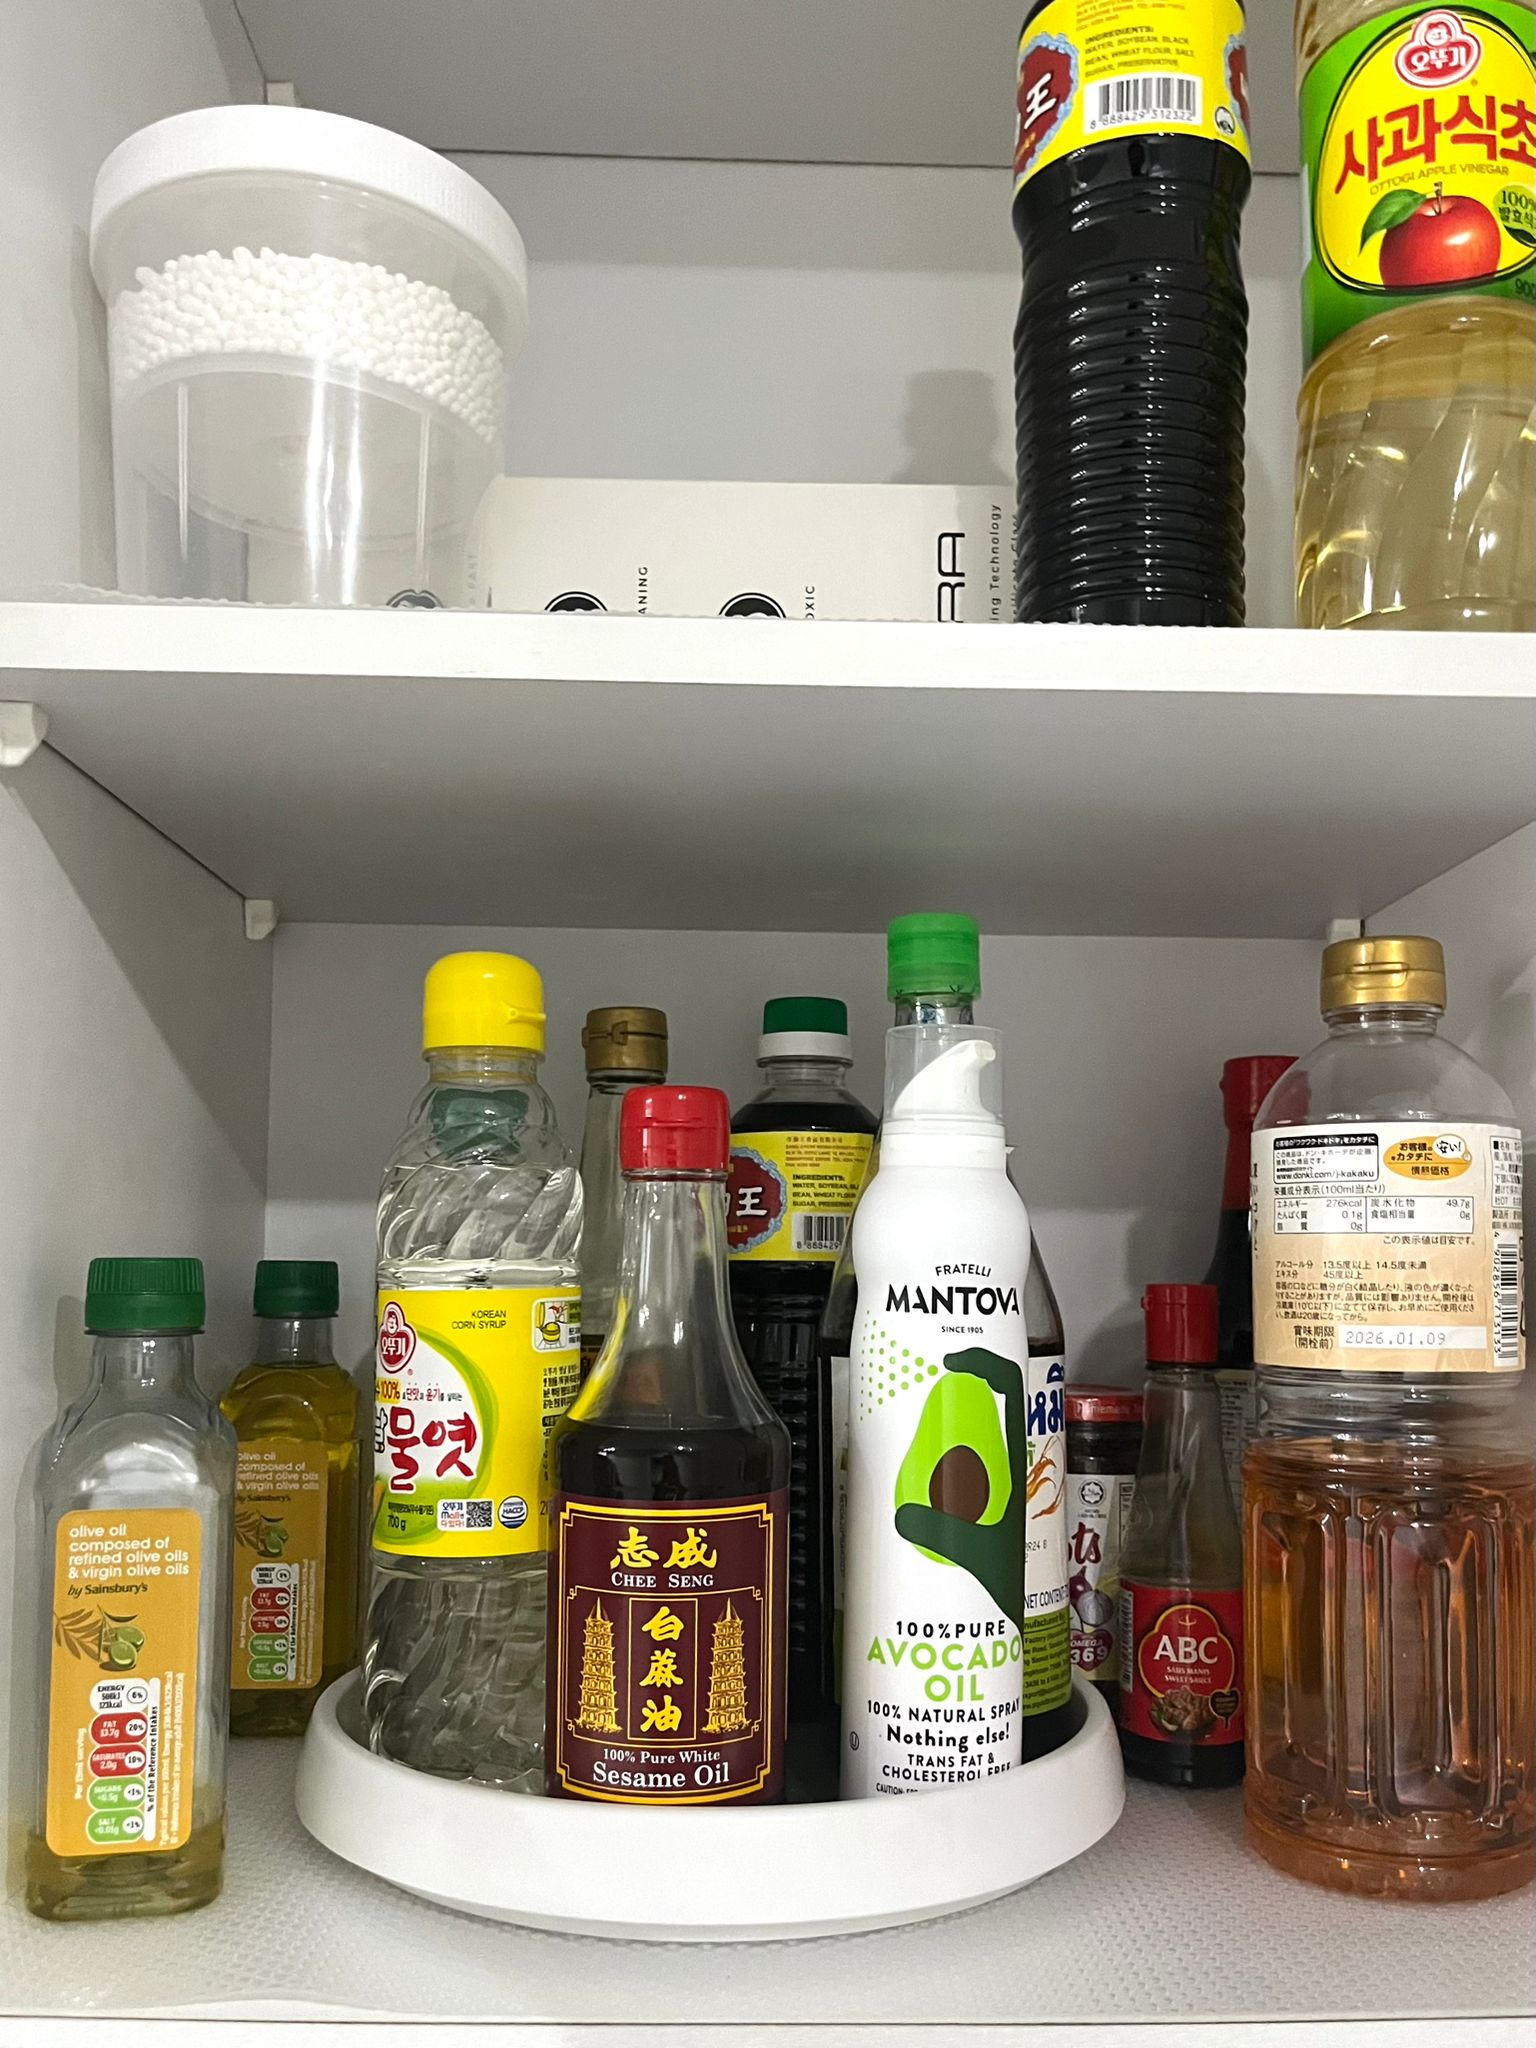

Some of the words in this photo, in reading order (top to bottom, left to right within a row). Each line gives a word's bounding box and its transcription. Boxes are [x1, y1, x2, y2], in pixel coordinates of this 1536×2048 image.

[1410, 46, 1467, 74] 오뚜기
[1335, 95, 1536, 196] 사과식초
[1370, 172, 1415, 196] OTTOGI
[1418, 164, 1457, 180] APPLE
[1461, 163, 1510, 176] VINEGAR
[990, 504, 1001, 590] Technology
[736, 1186, 767, 1217] 王
[1326, 1199, 1362, 1208] 276kcal
[1446, 1199, 1470, 1209] 49.7g
[935, 1263, 992, 1278] FRATELLI
[885, 1284, 1020, 1316] MANTOVA
[471, 1310, 506, 1318] KOREAN
[452, 1321, 475, 1330] CORN
[478, 1321, 507, 1329] SYRUP
[941, 1325, 966, 1334] SINCE
[967, 1326, 984, 1334] 1905
[1293, 1325, 1335, 1337] 賞味期限
[381, 1337, 406, 1356] 오뚜기
[1345, 1331, 1446, 1346] 2026.01.09
[387, 1406, 478, 1492] 물엿
[276, 1472, 299, 1480] olive
[245, 1481, 273, 1491] virgin
[276, 1481, 299, 1490] olive
[69, 1525, 105, 1538] olive
[109, 1524, 127, 1537] oil
[69, 1538, 151, 1552] composed
[154, 1536, 170, 1549] of
[69, 1552, 122, 1566] refined
[126, 1551, 161, 1563] olive
[165, 1550, 189, 1562] oils
[68, 1568, 79, 1580] &
[82, 1566, 122, 1581] virgin
[127, 1564, 161, 1576] olive
[165, 1563, 189, 1576] oils
[611, 1571, 657, 1588] CHEE
[668, 1573, 715, 1588] SENG
[67, 1584, 84, 1599] by
[85, 1582, 149, 1596] Sainsbury's
[867, 1634, 1021, 1671] AVOCADO
[1153, 1634, 1218, 1665] ABC
[98, 1685, 125, 1693] ENERGY
[924, 1674, 985, 1702] OIL
[867, 1699, 901, 1719] 100%
[909, 1707, 986, 1723] NATURAL
[991, 1697, 1020, 1720] SPRAY
[103, 1720, 117, 1728] FAT
[128, 1723, 144, 1731] 20%
[149, 1706, 158, 1736] Intakes
[886, 1723, 969, 1753] Nothing
[976, 1722, 1010, 1746] else!
[148, 1738, 157, 1778] Reference
[603, 1748, 636, 1762] 100%
[641, 1751, 675, 1764] Pure
[679, 1750, 721, 1764] White
[907, 1753, 955, 1768] TRANS
[961, 1754, 983, 1767] FAT
[987, 1752, 995, 1765] &
[593, 1761, 686, 1789] Sesame
[694, 1762, 730, 1787] Oil
[147, 1794, 155, 1803] of
[98, 1818, 116, 1826] SALT
